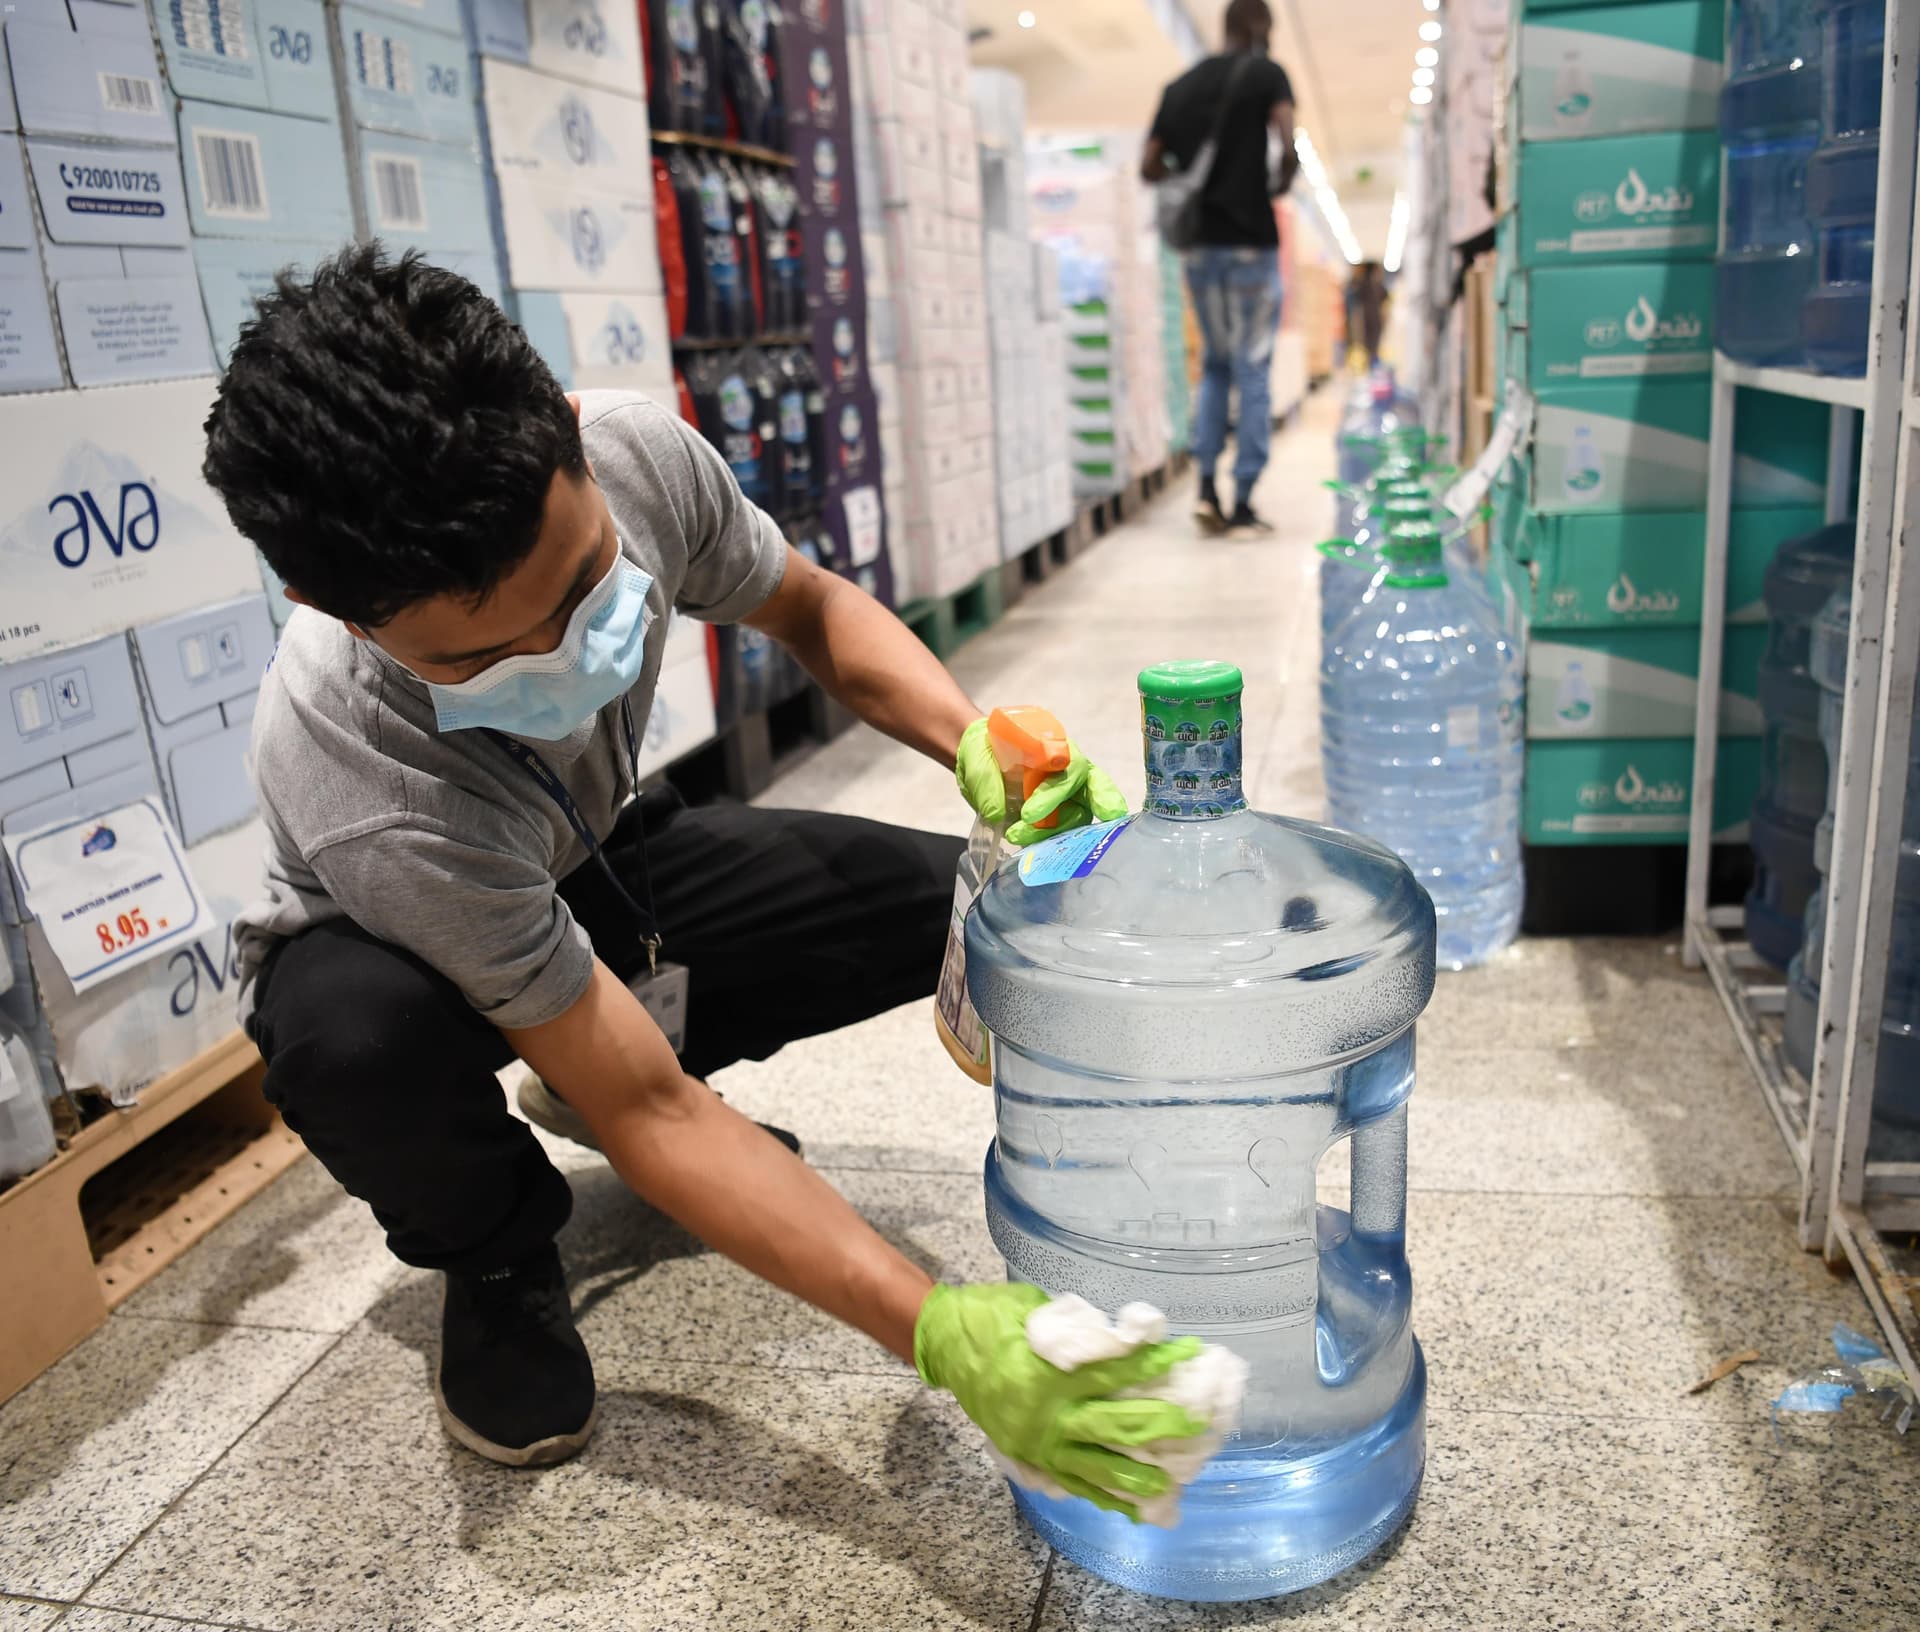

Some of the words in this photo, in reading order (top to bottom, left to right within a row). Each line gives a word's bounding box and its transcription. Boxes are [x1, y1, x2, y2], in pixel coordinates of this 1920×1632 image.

[269, 25, 313, 65] ava
[73, 166, 160, 192] 920010725
[48, 481, 160, 569] ava
[8, 627, 20, 639] 18
[22, 623, 40, 639] pcs
[96, 907, 150, 954] 8.95
[168, 922, 241, 1017] av
